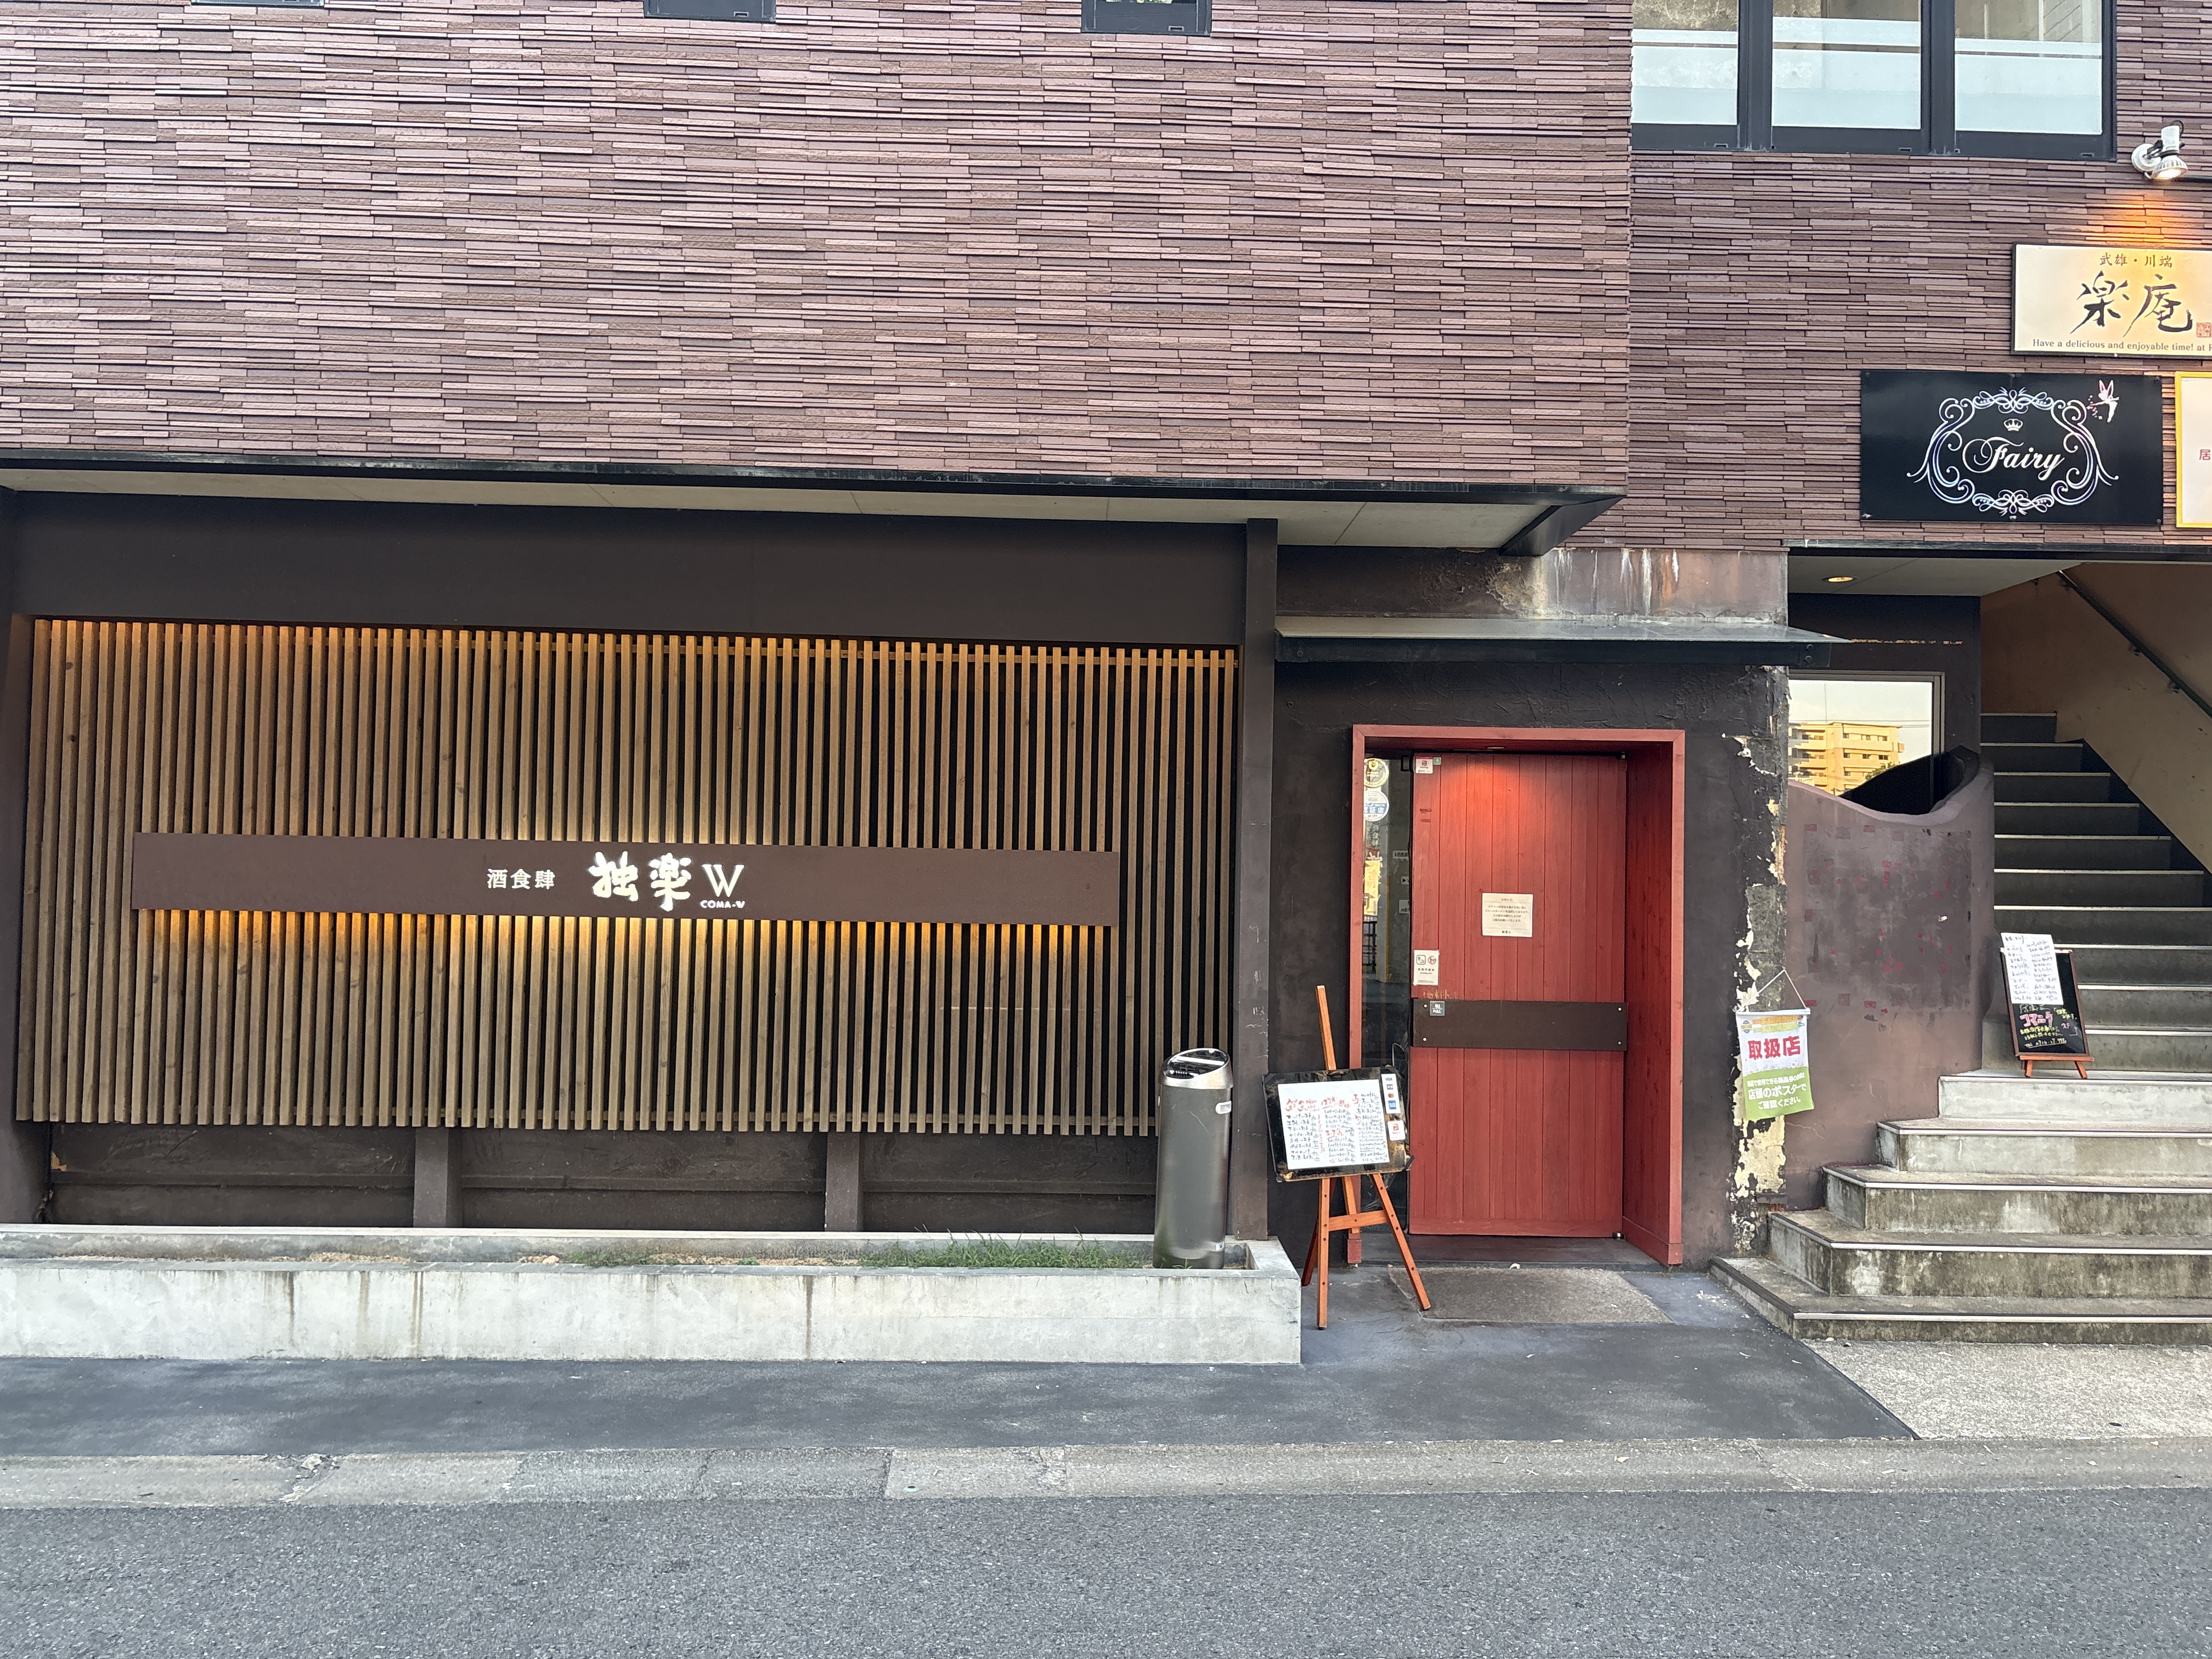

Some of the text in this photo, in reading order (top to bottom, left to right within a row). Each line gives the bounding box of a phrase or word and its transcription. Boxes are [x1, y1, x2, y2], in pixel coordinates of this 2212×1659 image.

[2100, 252, 2172, 268] 武雄・川端
[2070, 270, 2193, 337] 楽庵
[2033, 339, 2054, 347] Have
[2066, 340, 2105, 349] delicious
[2127, 342, 2169, 351] enjoyable
[2172, 343, 2194, 351] time!
[1962, 436, 2066, 481] Fairy
[487, 868, 556, 890] 酒食肆
[1747, 1035, 1801, 1060] 取扱店
[1748, 1083, 1807, 1100] 店頭のポスターで
